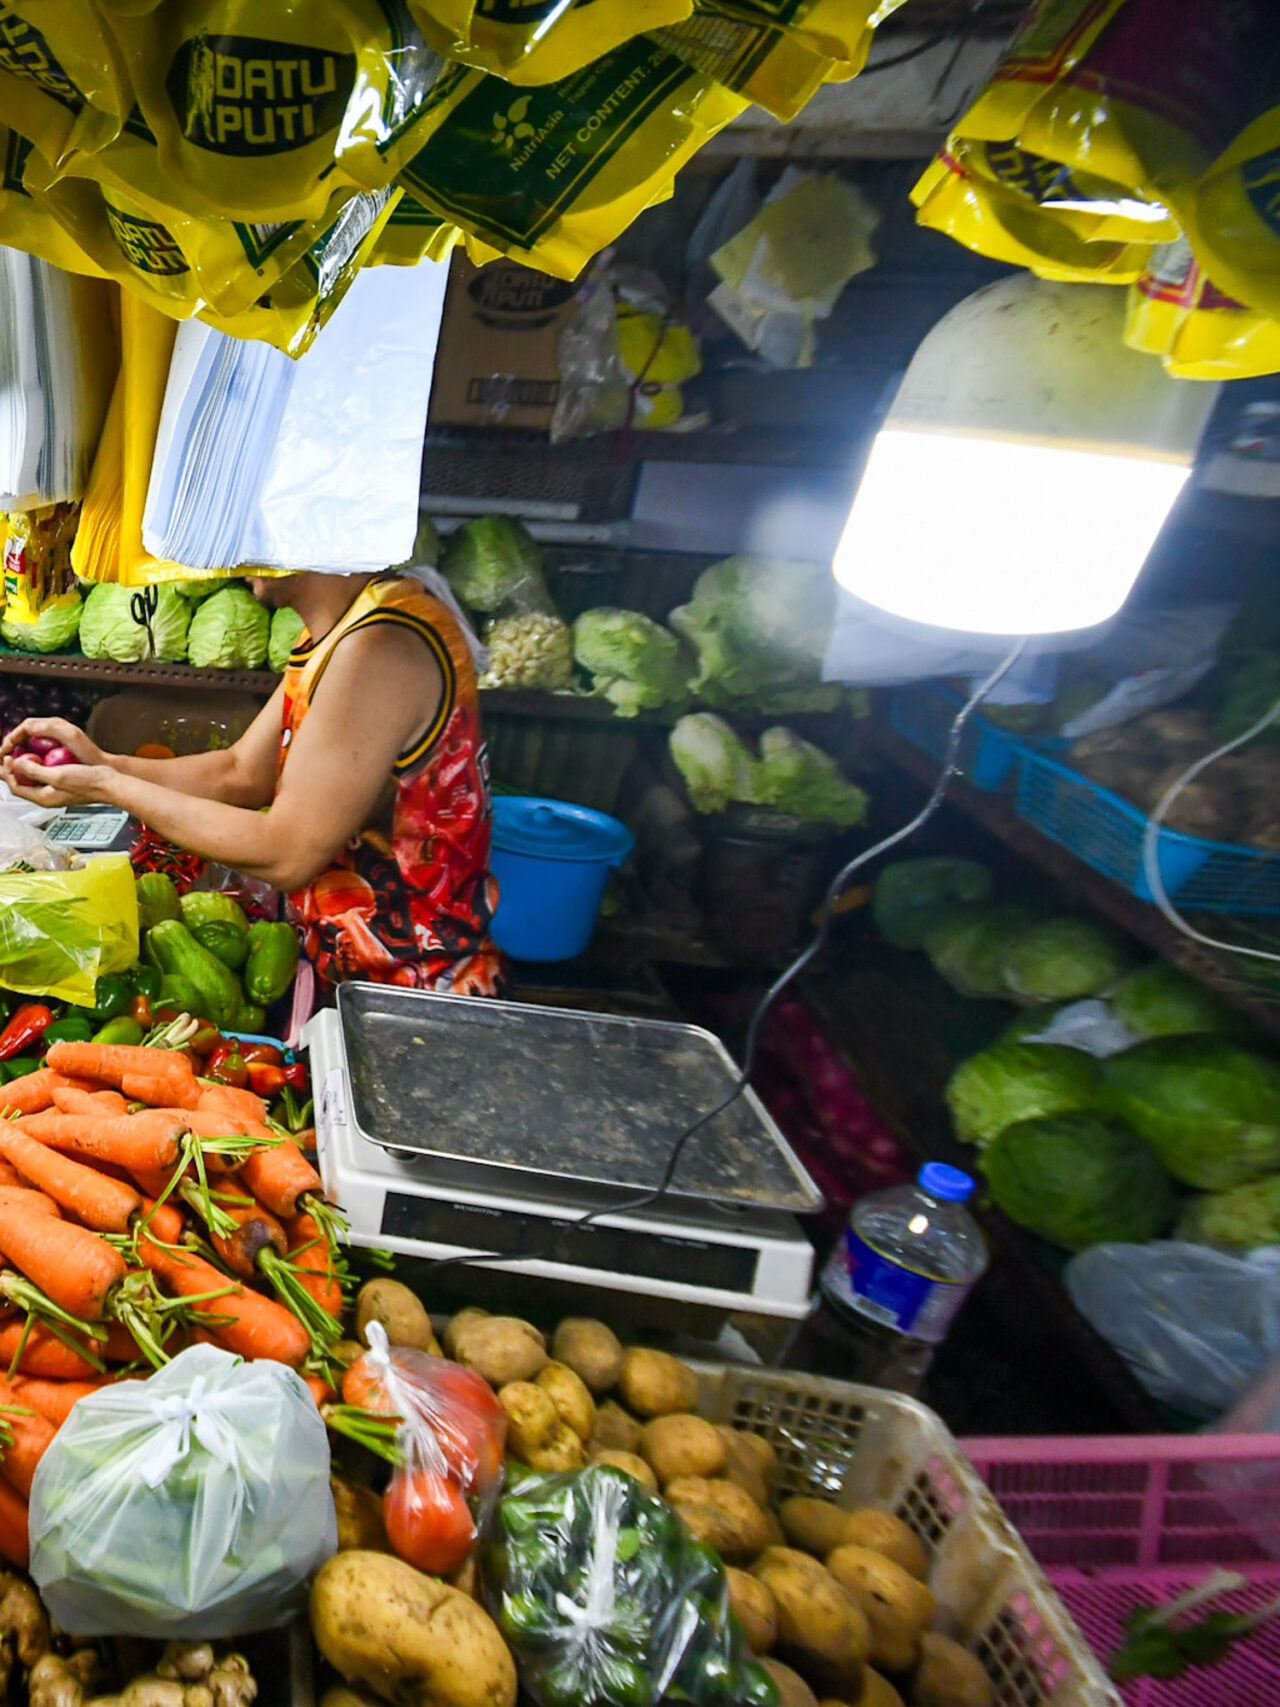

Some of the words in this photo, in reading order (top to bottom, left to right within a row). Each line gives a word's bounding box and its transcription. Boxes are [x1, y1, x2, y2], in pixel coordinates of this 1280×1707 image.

[215, 53, 336, 99] DATU
[215, 103, 314, 143] PUTI
[509, 109, 565, 172] NutriAsia
[545, 141, 577, 181] NET
[576, 65, 651, 143] CONTENT:
